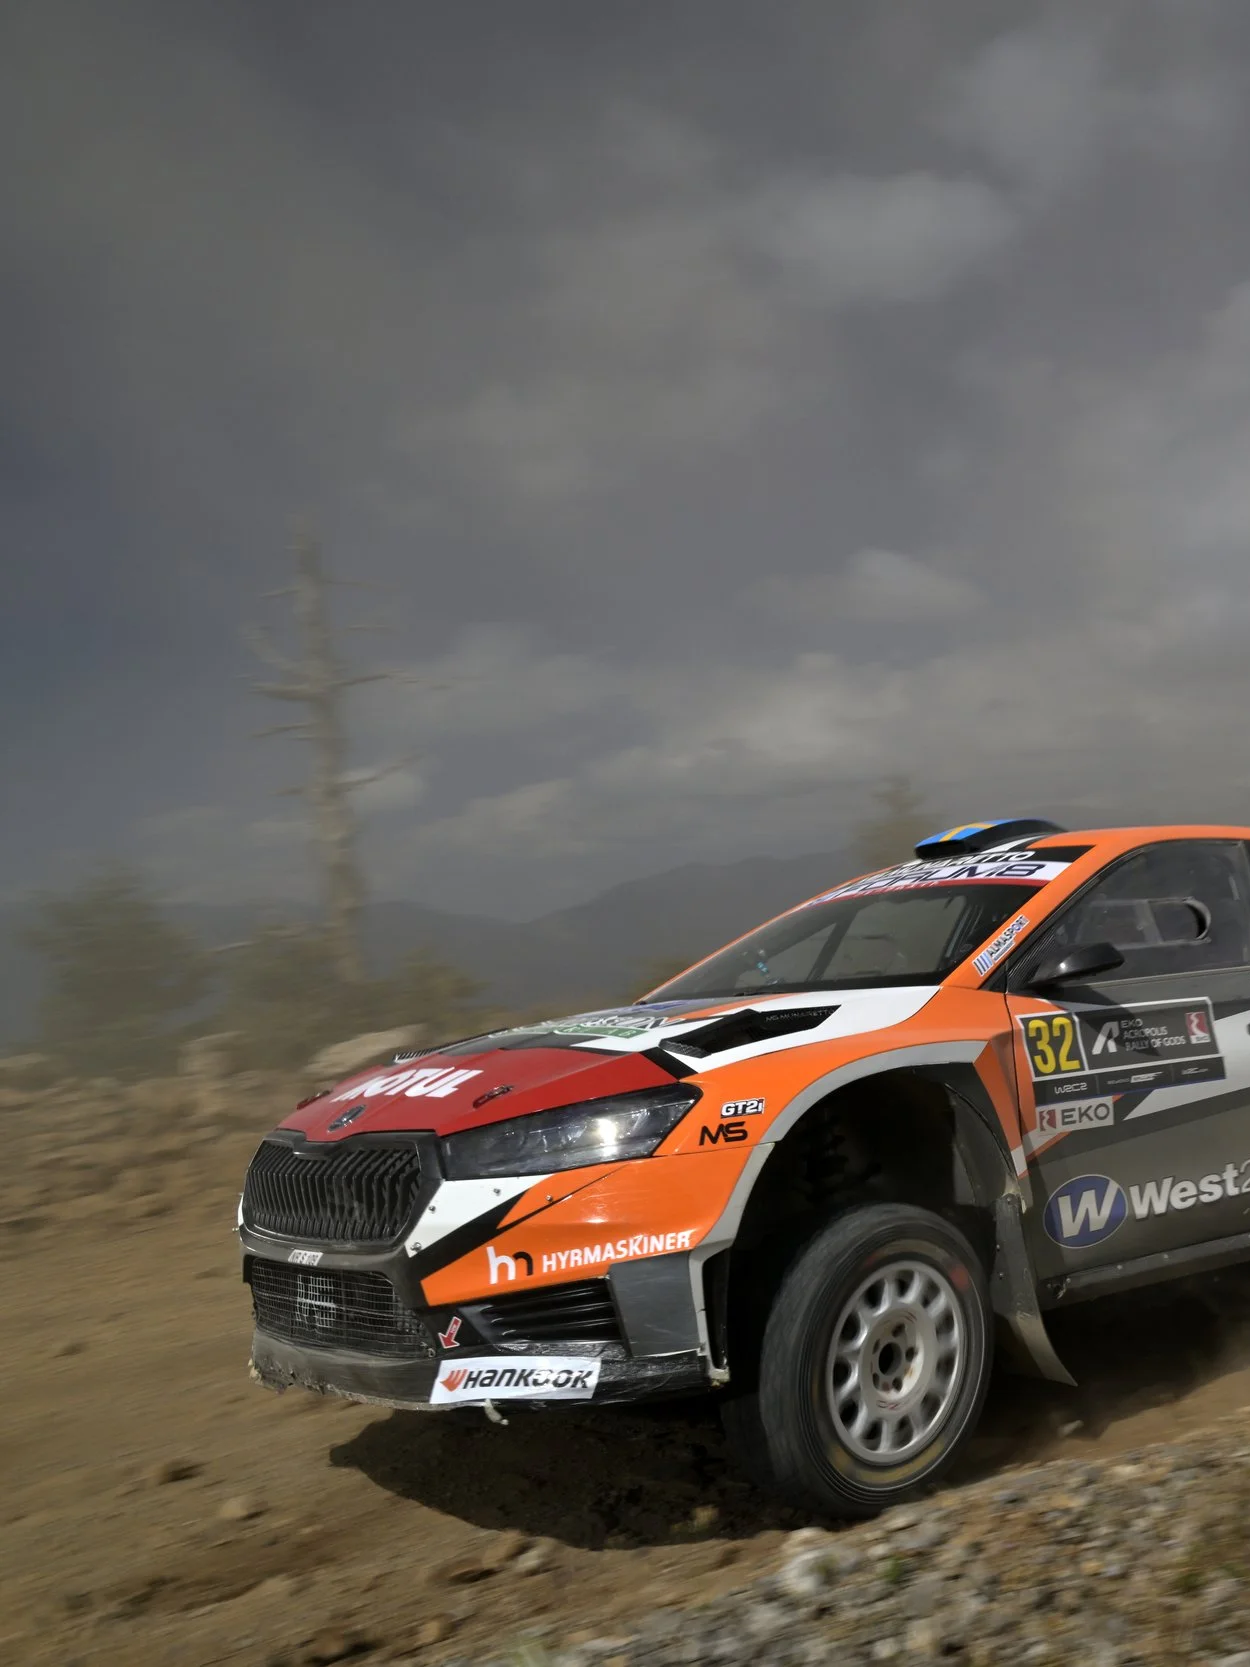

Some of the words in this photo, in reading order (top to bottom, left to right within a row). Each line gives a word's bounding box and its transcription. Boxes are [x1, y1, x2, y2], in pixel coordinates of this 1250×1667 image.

[986, 915, 1028, 957] ALMASPORT
[1121, 1018, 1143, 1027] EKO
[1123, 1026, 1168, 1039] ACROPOLIS
[1028, 1017, 1080, 1074] 32
[1125, 1041, 1149, 1051] RALLY
[1150, 1039, 1162, 1049] OF
[1162, 1036, 1186, 1047] GODS
[330, 1066, 484, 1102] MOTUL
[1061, 1103, 1110, 1126] EKO
[699, 1121, 748, 1146] MS
[542, 1229, 698, 1273] HYRMASKINER
